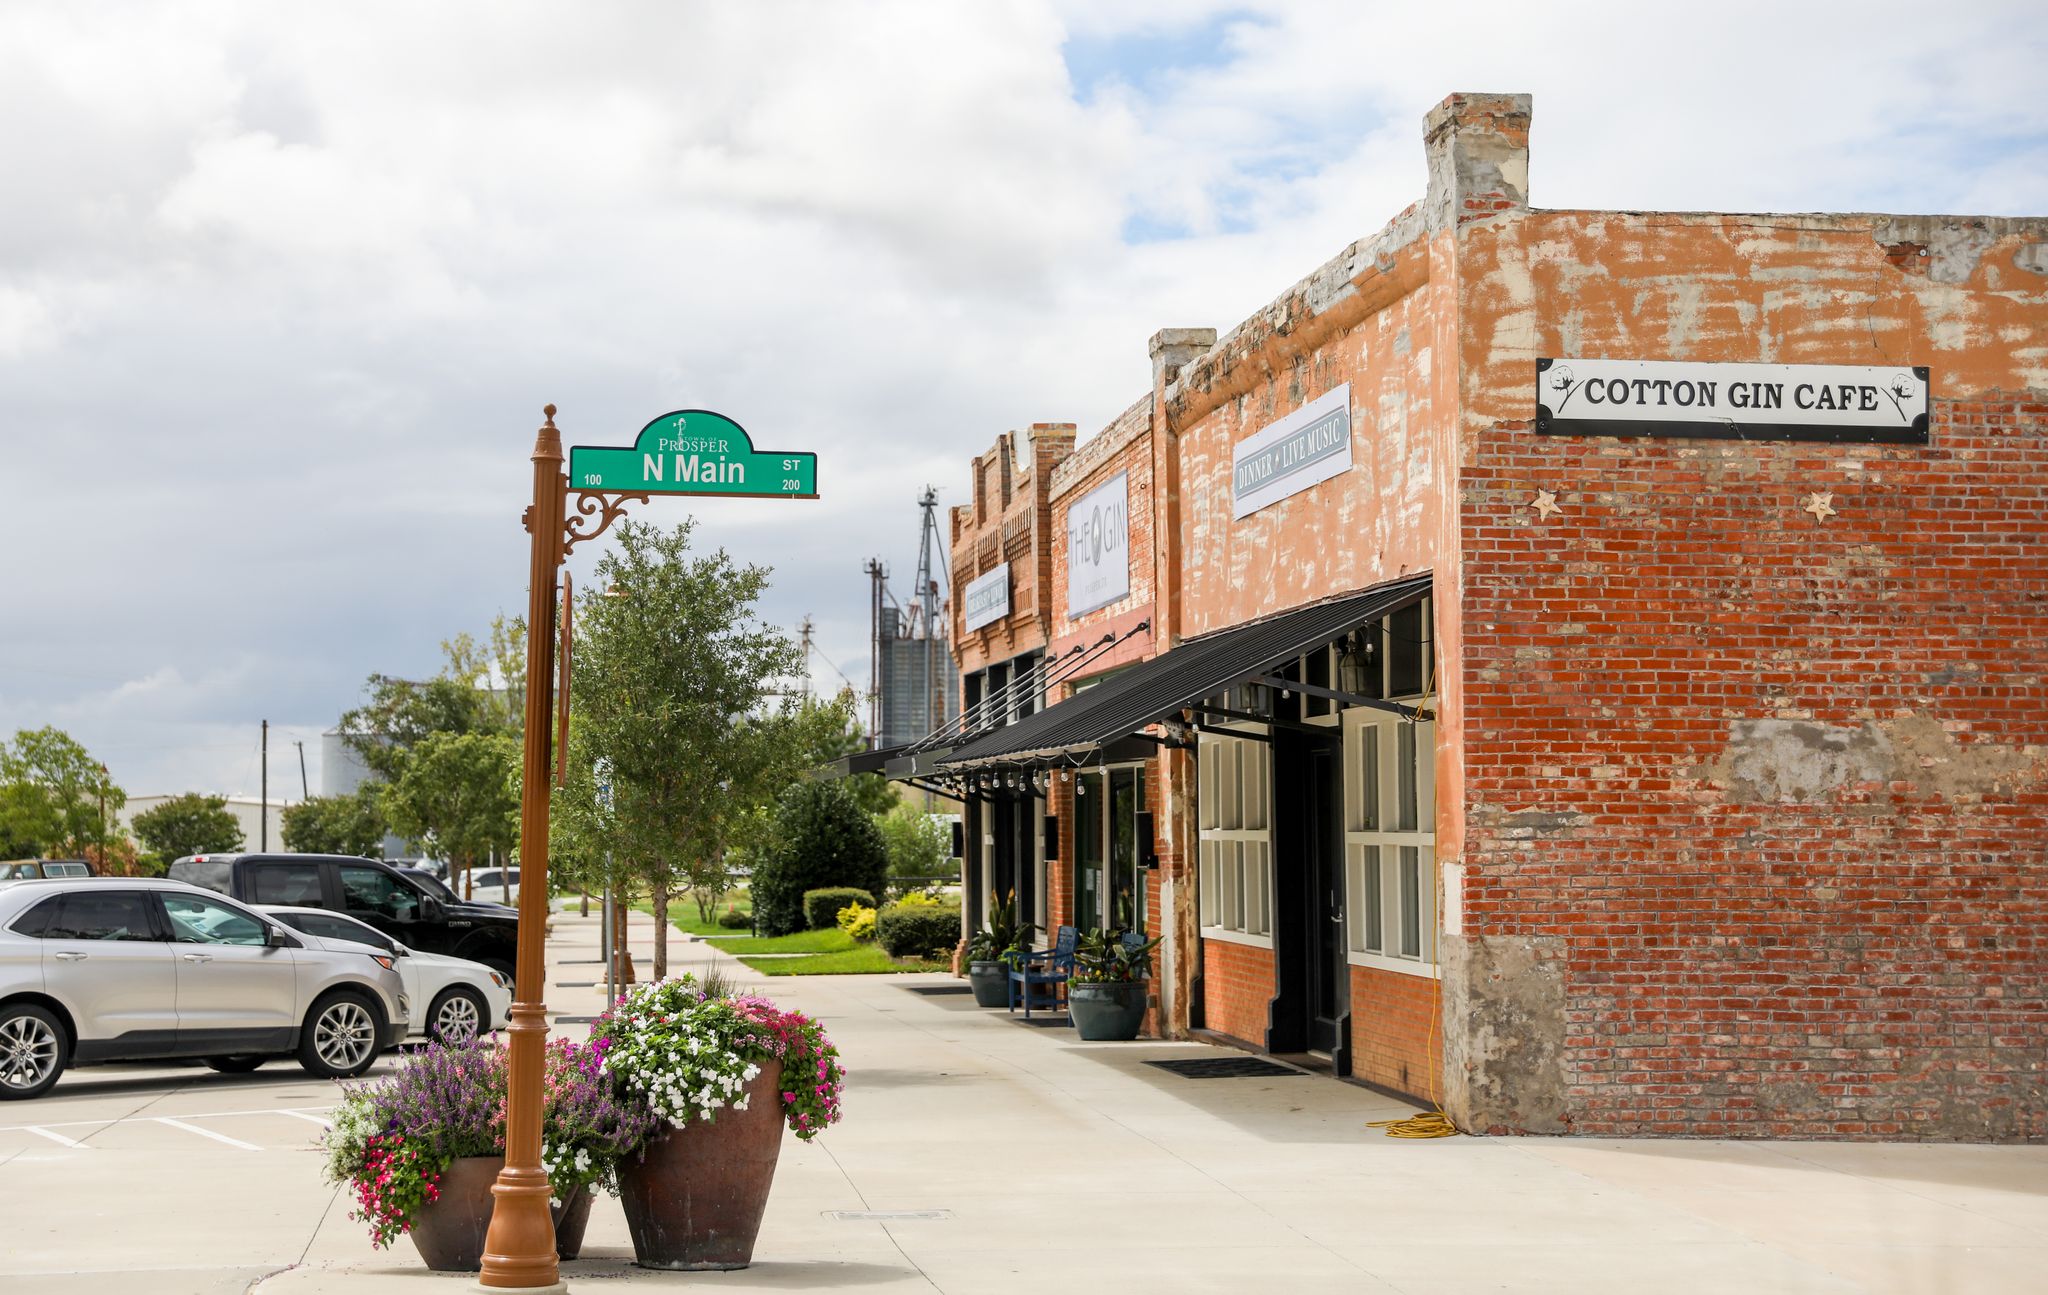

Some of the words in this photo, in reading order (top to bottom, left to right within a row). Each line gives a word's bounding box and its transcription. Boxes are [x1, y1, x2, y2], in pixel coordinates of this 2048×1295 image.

[1584, 377, 1717, 407] COTTON
[1727, 381, 1784, 409] GIN
[1793, 383, 1879, 412] CAFE
[643, 453, 663, 482] N
[675, 454, 745, 484] Main
[782, 459, 801, 471] ST
[1238, 453, 1273, 490] DINNER
[1282, 436, 1306, 469] LIVE
[1307, 418, 1340, 457] MUSIC
[584, 474, 602, 486] 100
[782, 479, 801, 491] 200
[1069, 521, 1090, 569] THE
[1103, 499, 1125, 553] GIN
